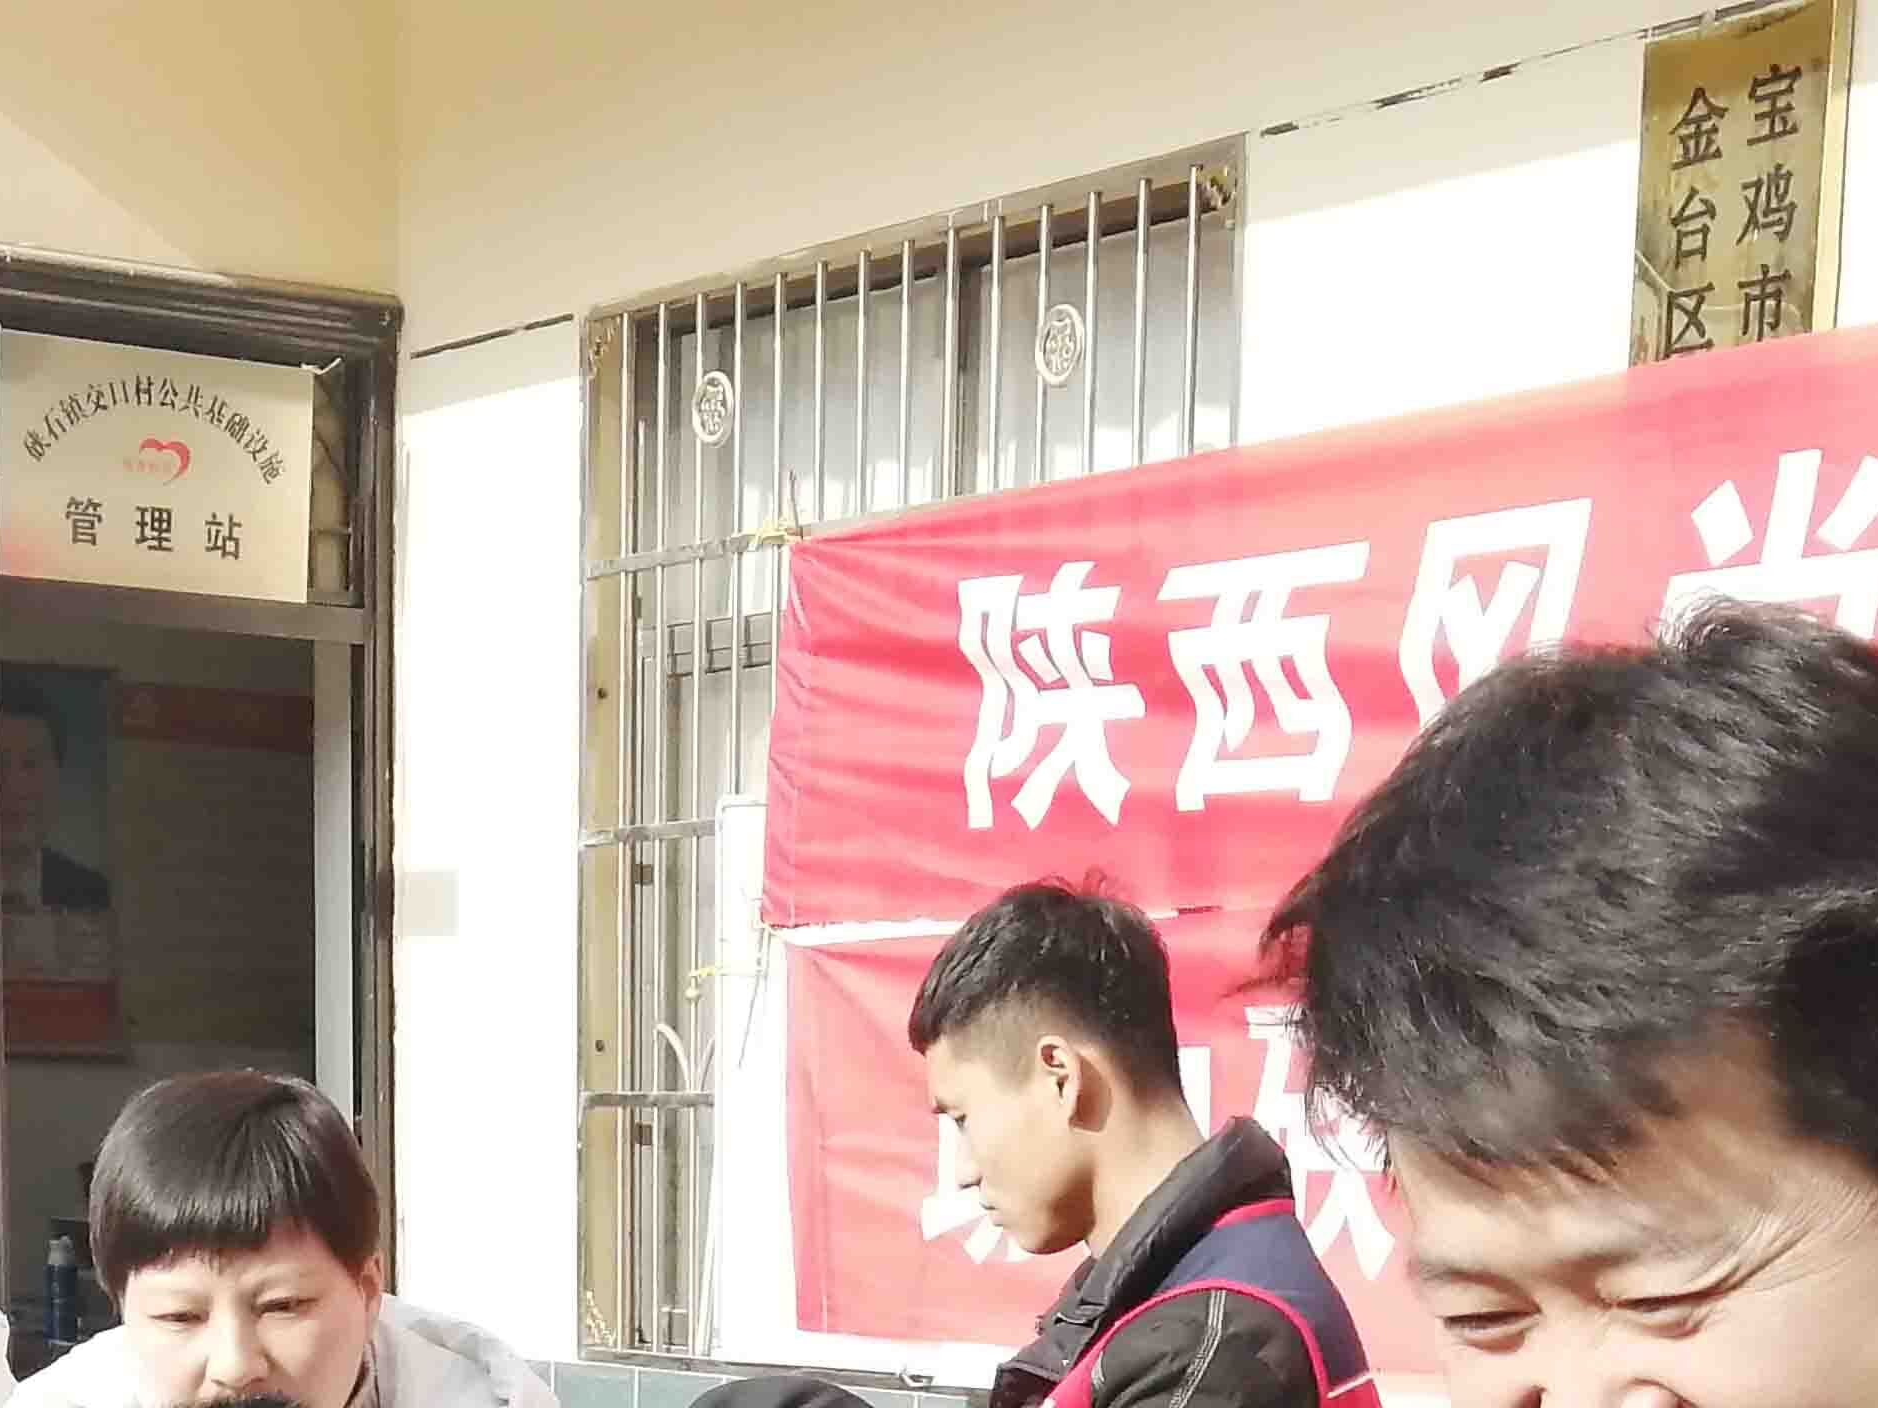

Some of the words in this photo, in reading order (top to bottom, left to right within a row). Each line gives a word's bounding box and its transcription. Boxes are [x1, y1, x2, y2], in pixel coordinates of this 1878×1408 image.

[1663, 87, 1730, 360] 金台区
[1735, 63, 1803, 342] 宝鸡市
[65, 496, 243, 560] 管理站
